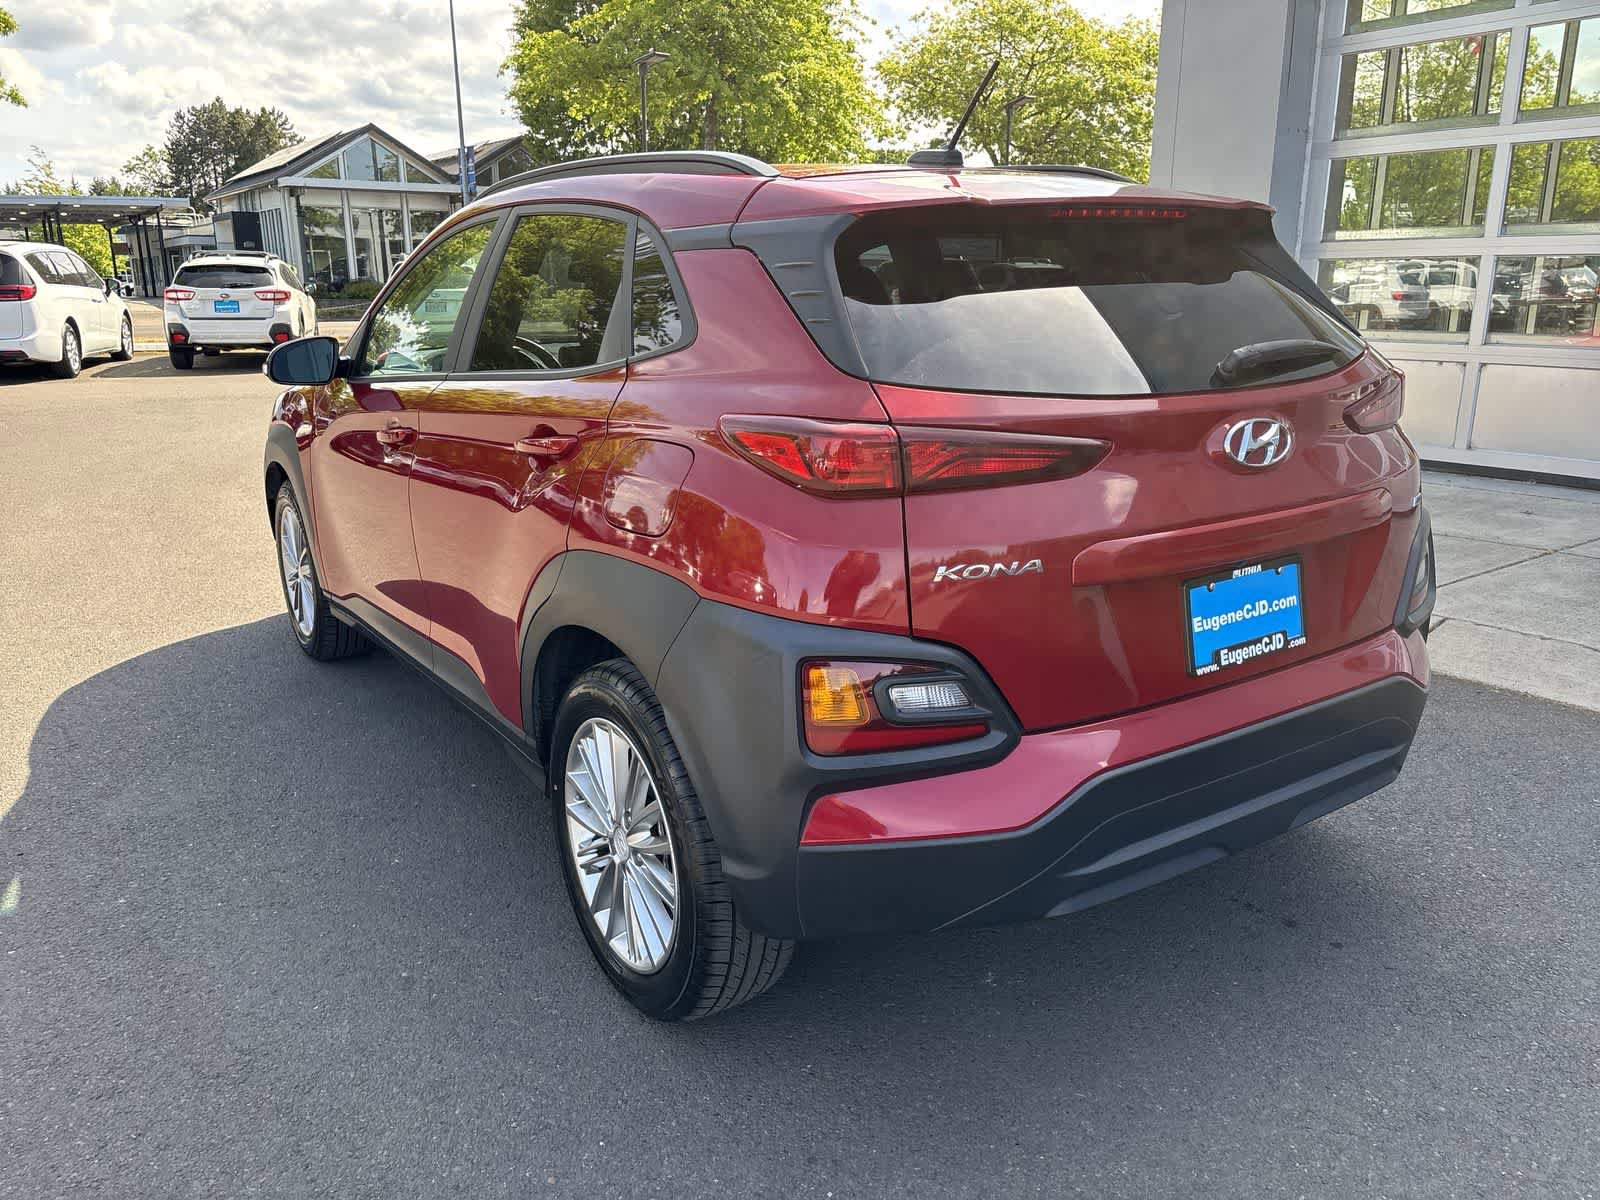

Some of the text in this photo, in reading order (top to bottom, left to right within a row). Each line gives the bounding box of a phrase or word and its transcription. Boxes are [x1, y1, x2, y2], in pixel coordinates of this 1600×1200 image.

[932, 559, 1044, 582] KONA
[1192, 595, 1297, 633] EugeneCJD.com
[1220, 633, 1284, 666] EugeneCJD
